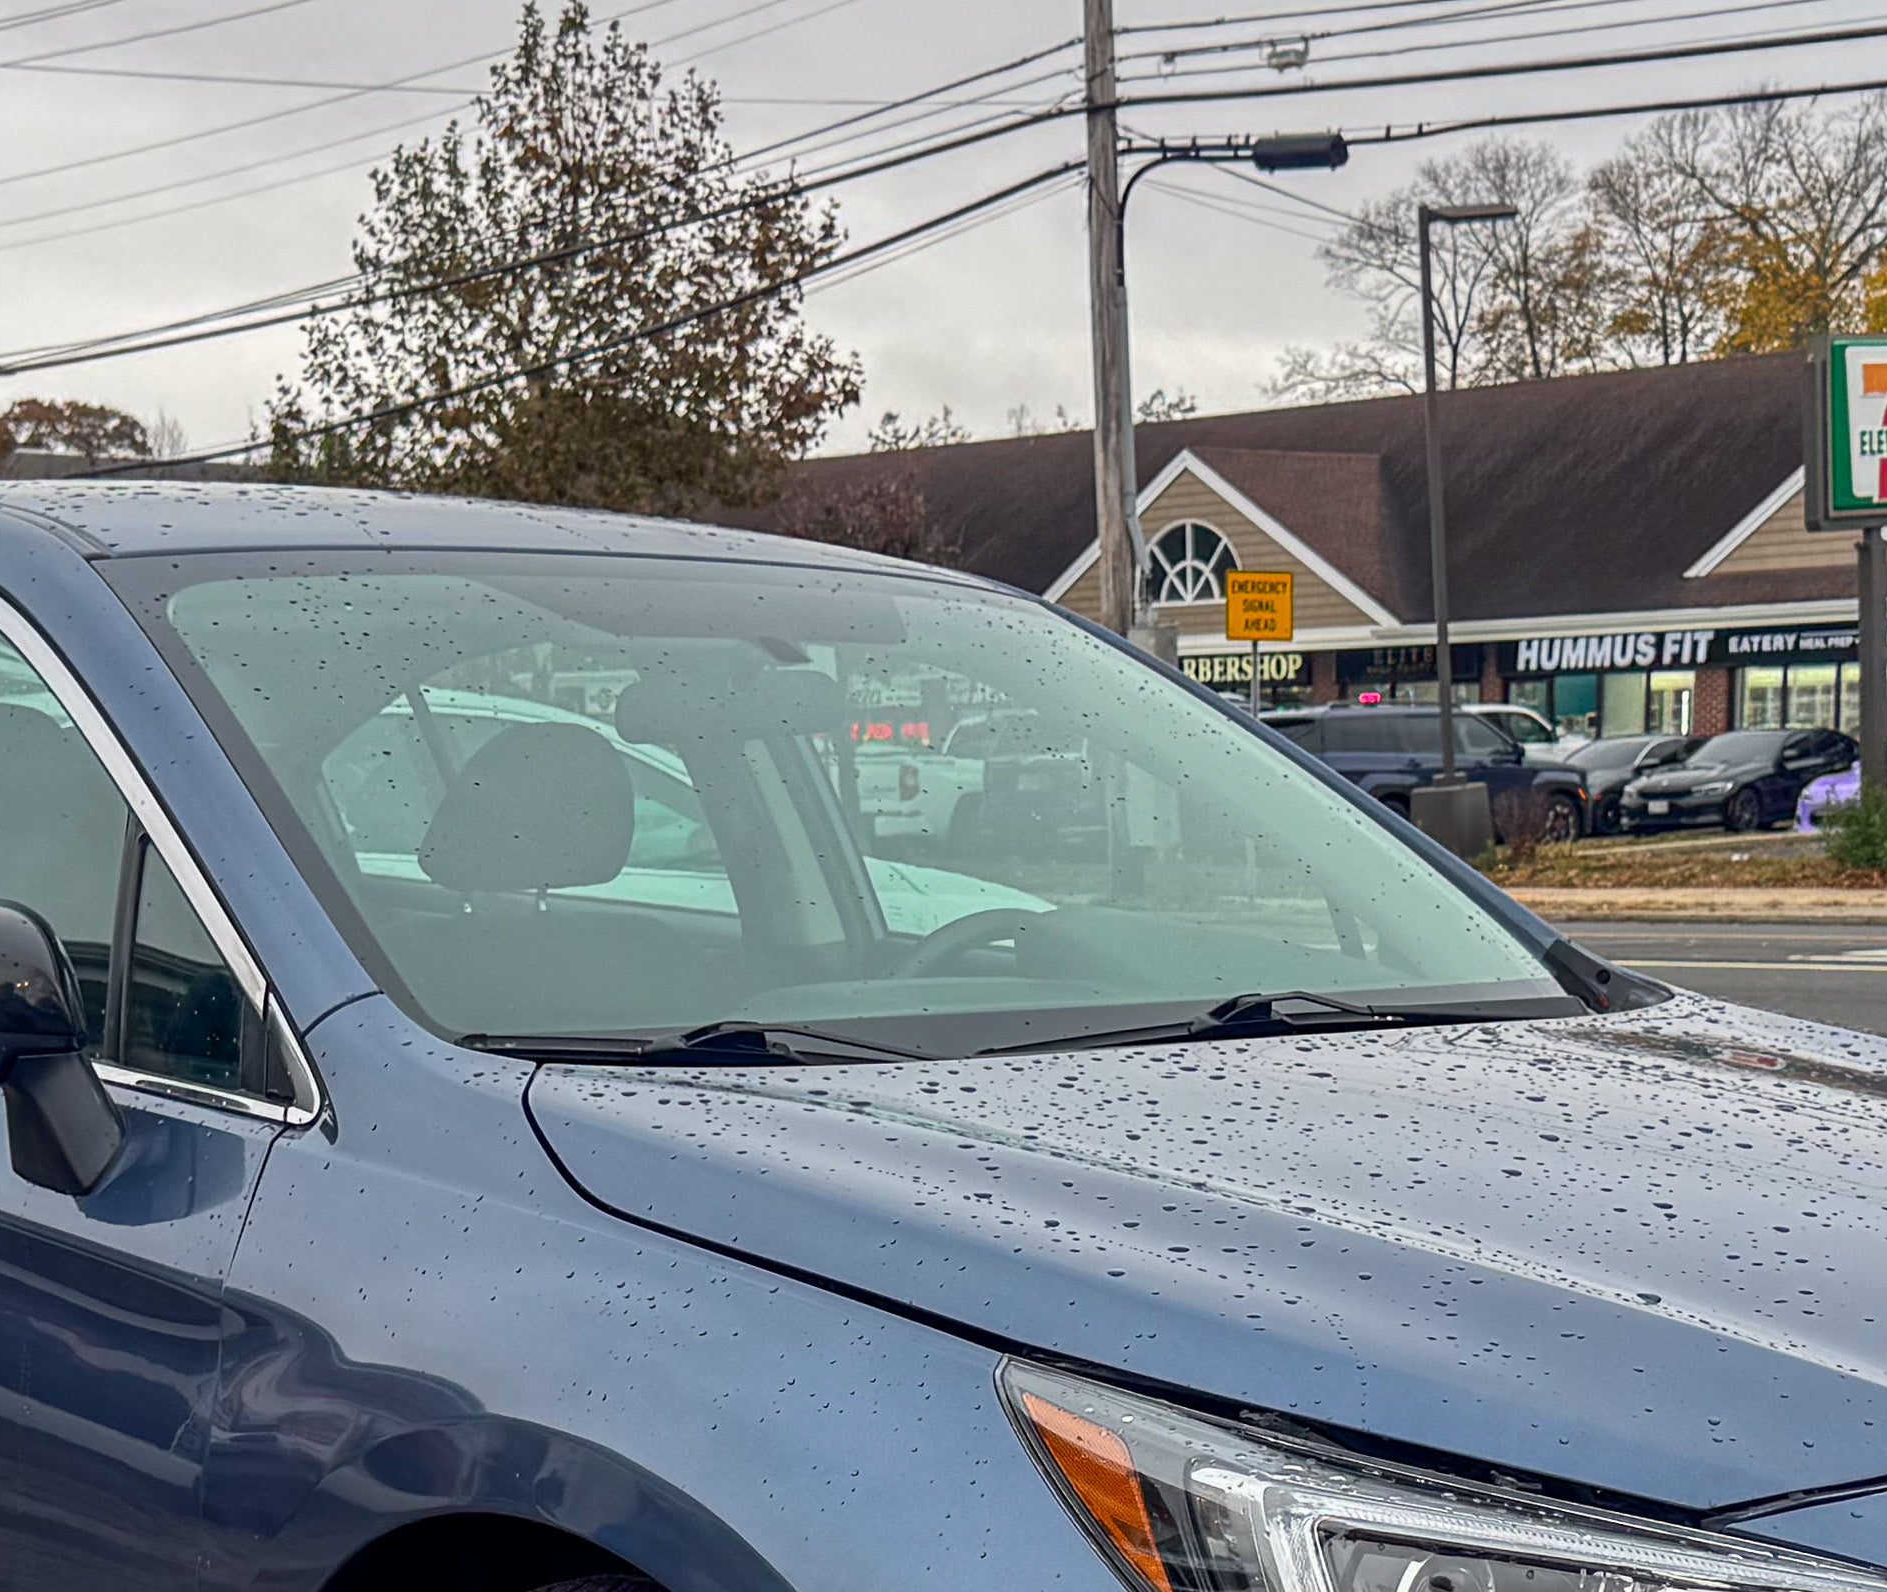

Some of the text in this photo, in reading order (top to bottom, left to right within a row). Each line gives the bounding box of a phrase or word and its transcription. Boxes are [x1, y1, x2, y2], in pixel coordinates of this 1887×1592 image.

[1231, 580, 1288, 594] EMERGENCY
[1242, 599, 1277, 613] SIGNAL
[1244, 618, 1277, 632] AHEAD
[1516, 630, 1715, 671] HUMMUS FIT
[1728, 632, 1799, 653] EATERY
[1183, 653, 1303, 683] RBERSHOP
